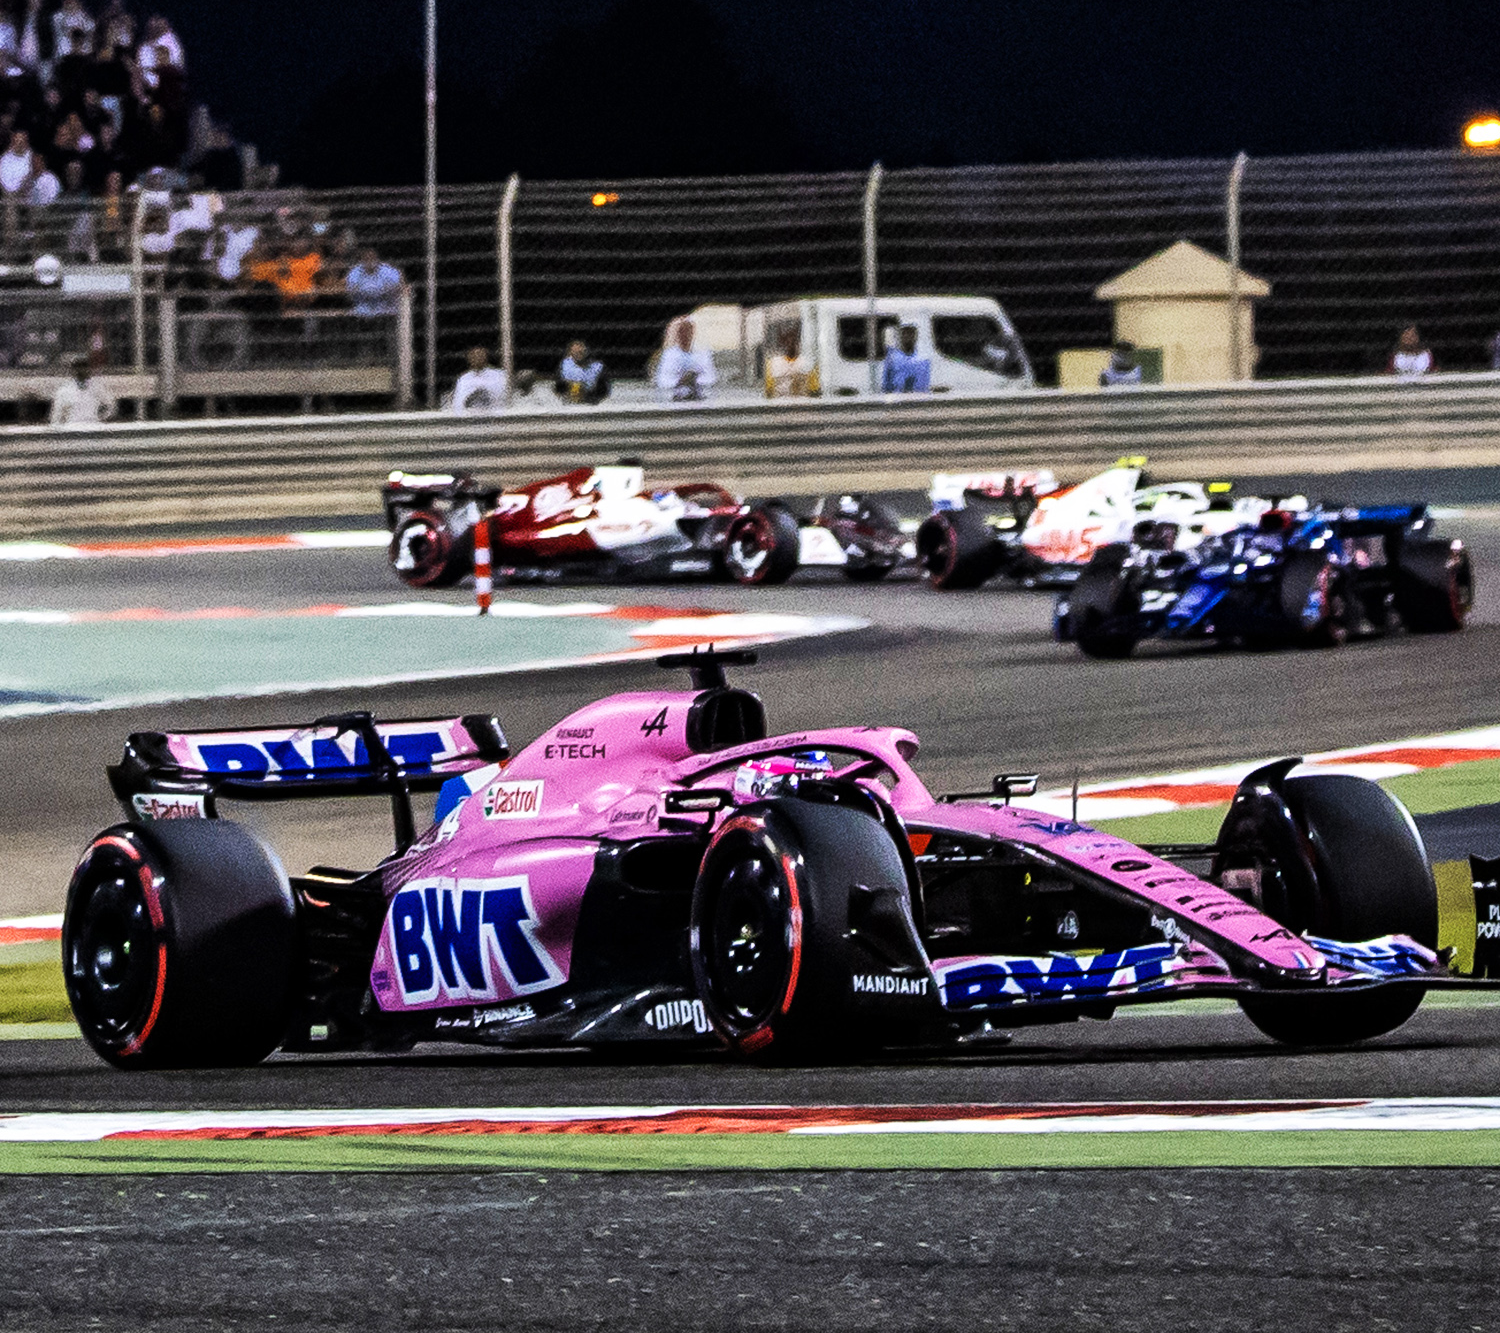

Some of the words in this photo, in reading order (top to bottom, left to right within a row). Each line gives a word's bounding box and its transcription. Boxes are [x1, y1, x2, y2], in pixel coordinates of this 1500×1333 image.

[494, 786, 539, 814] Castrol
[392, 886, 551, 994] BWT
[852, 974, 930, 996] MANDIANT
